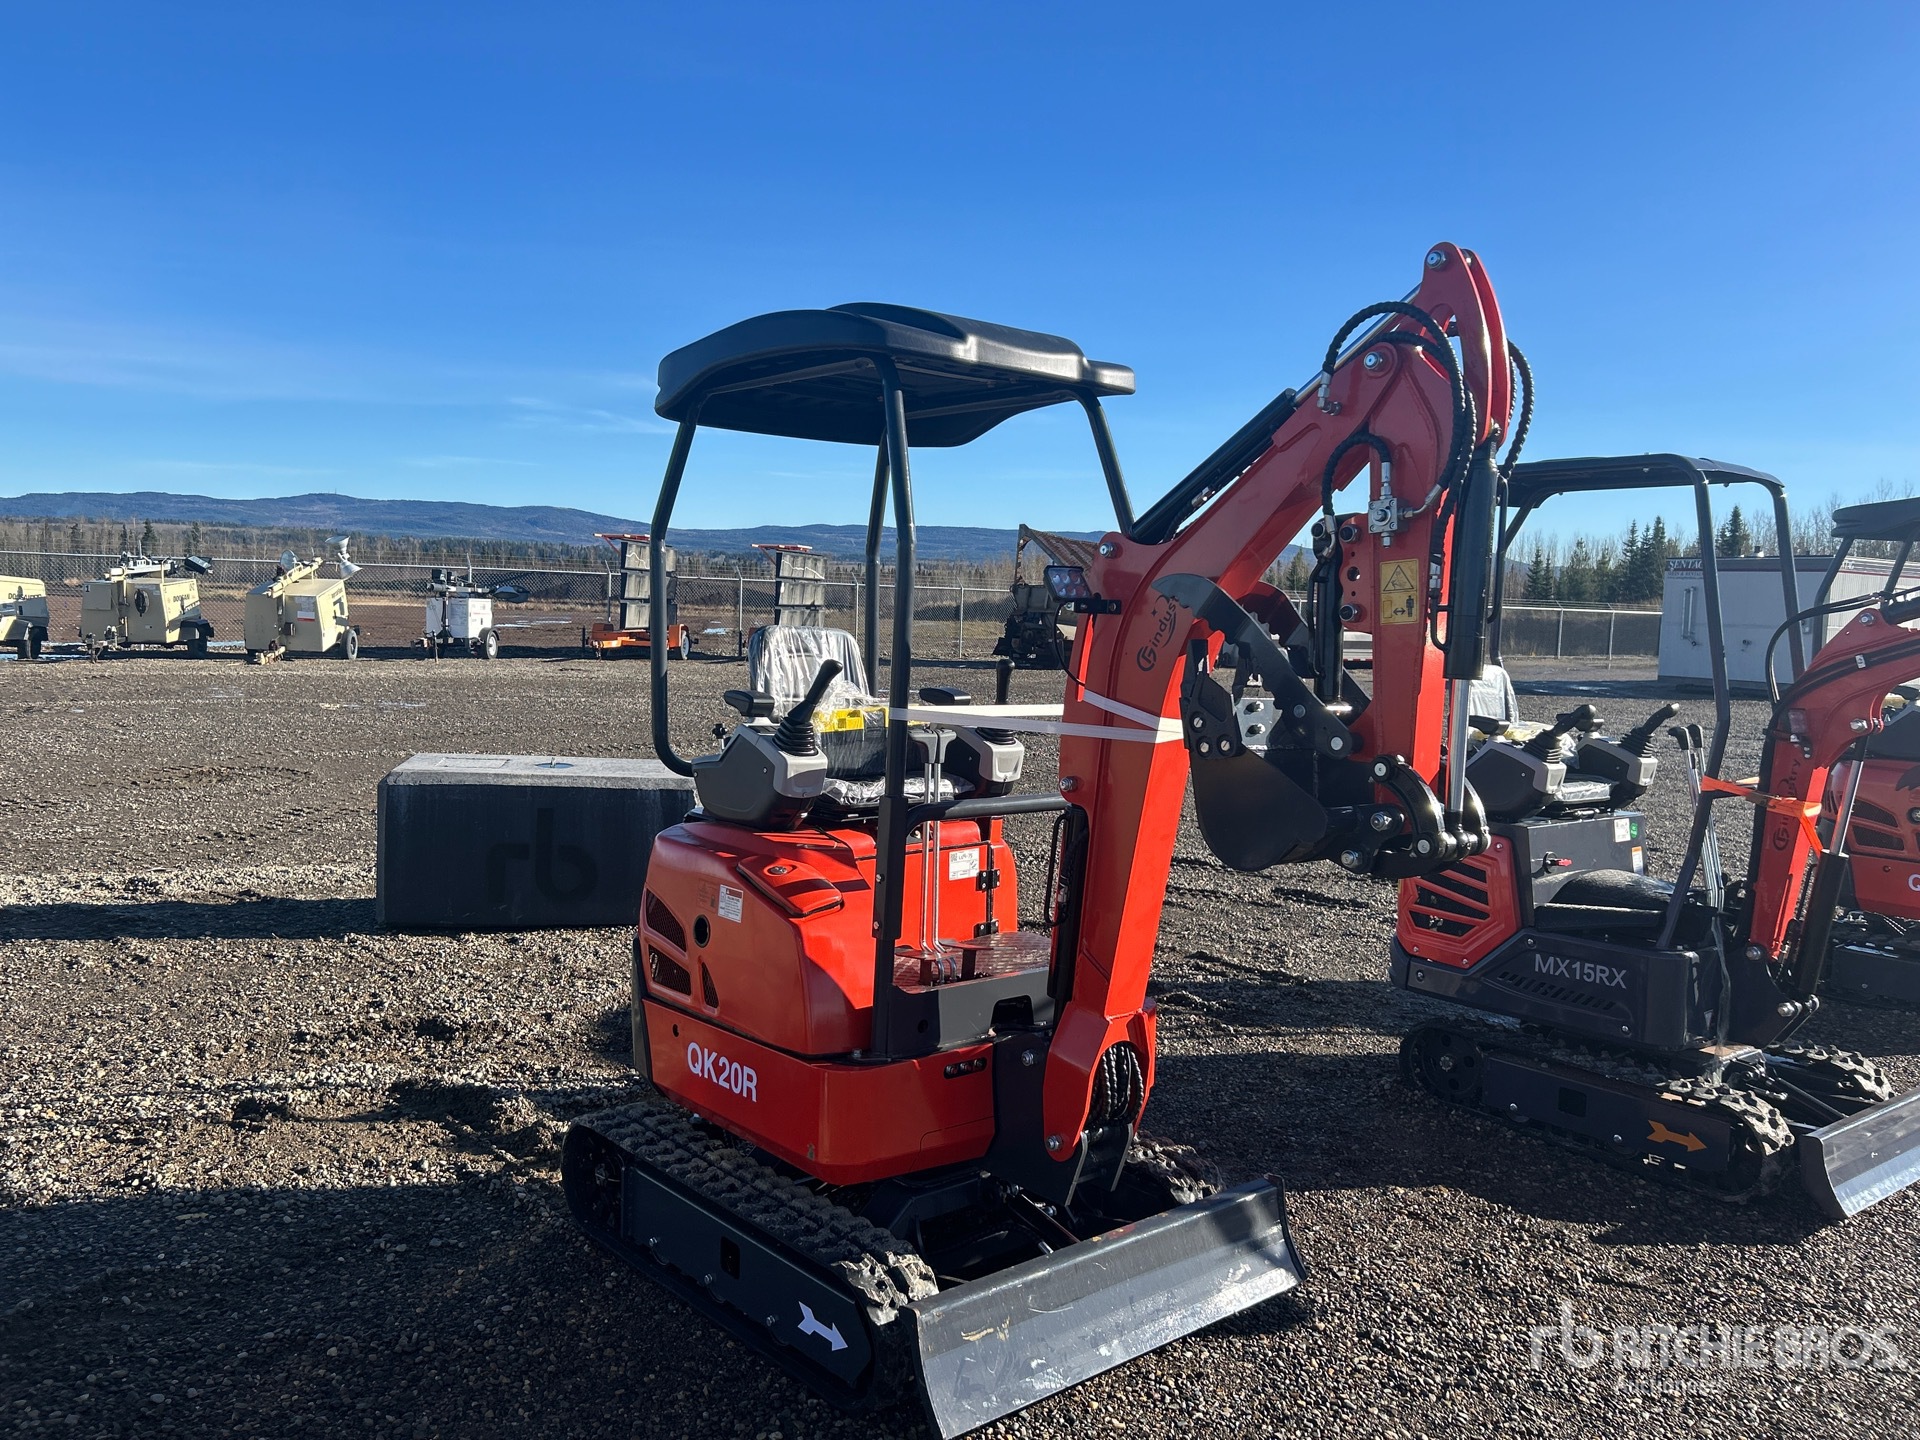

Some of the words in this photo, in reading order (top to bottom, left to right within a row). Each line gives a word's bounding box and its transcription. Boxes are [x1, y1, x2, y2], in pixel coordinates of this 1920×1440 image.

[1136, 595, 1180, 672] Gindust
[486, 808, 599, 904] rb
[1534, 953, 1627, 990] MX15RX
[687, 1041, 758, 1103] QK20R
